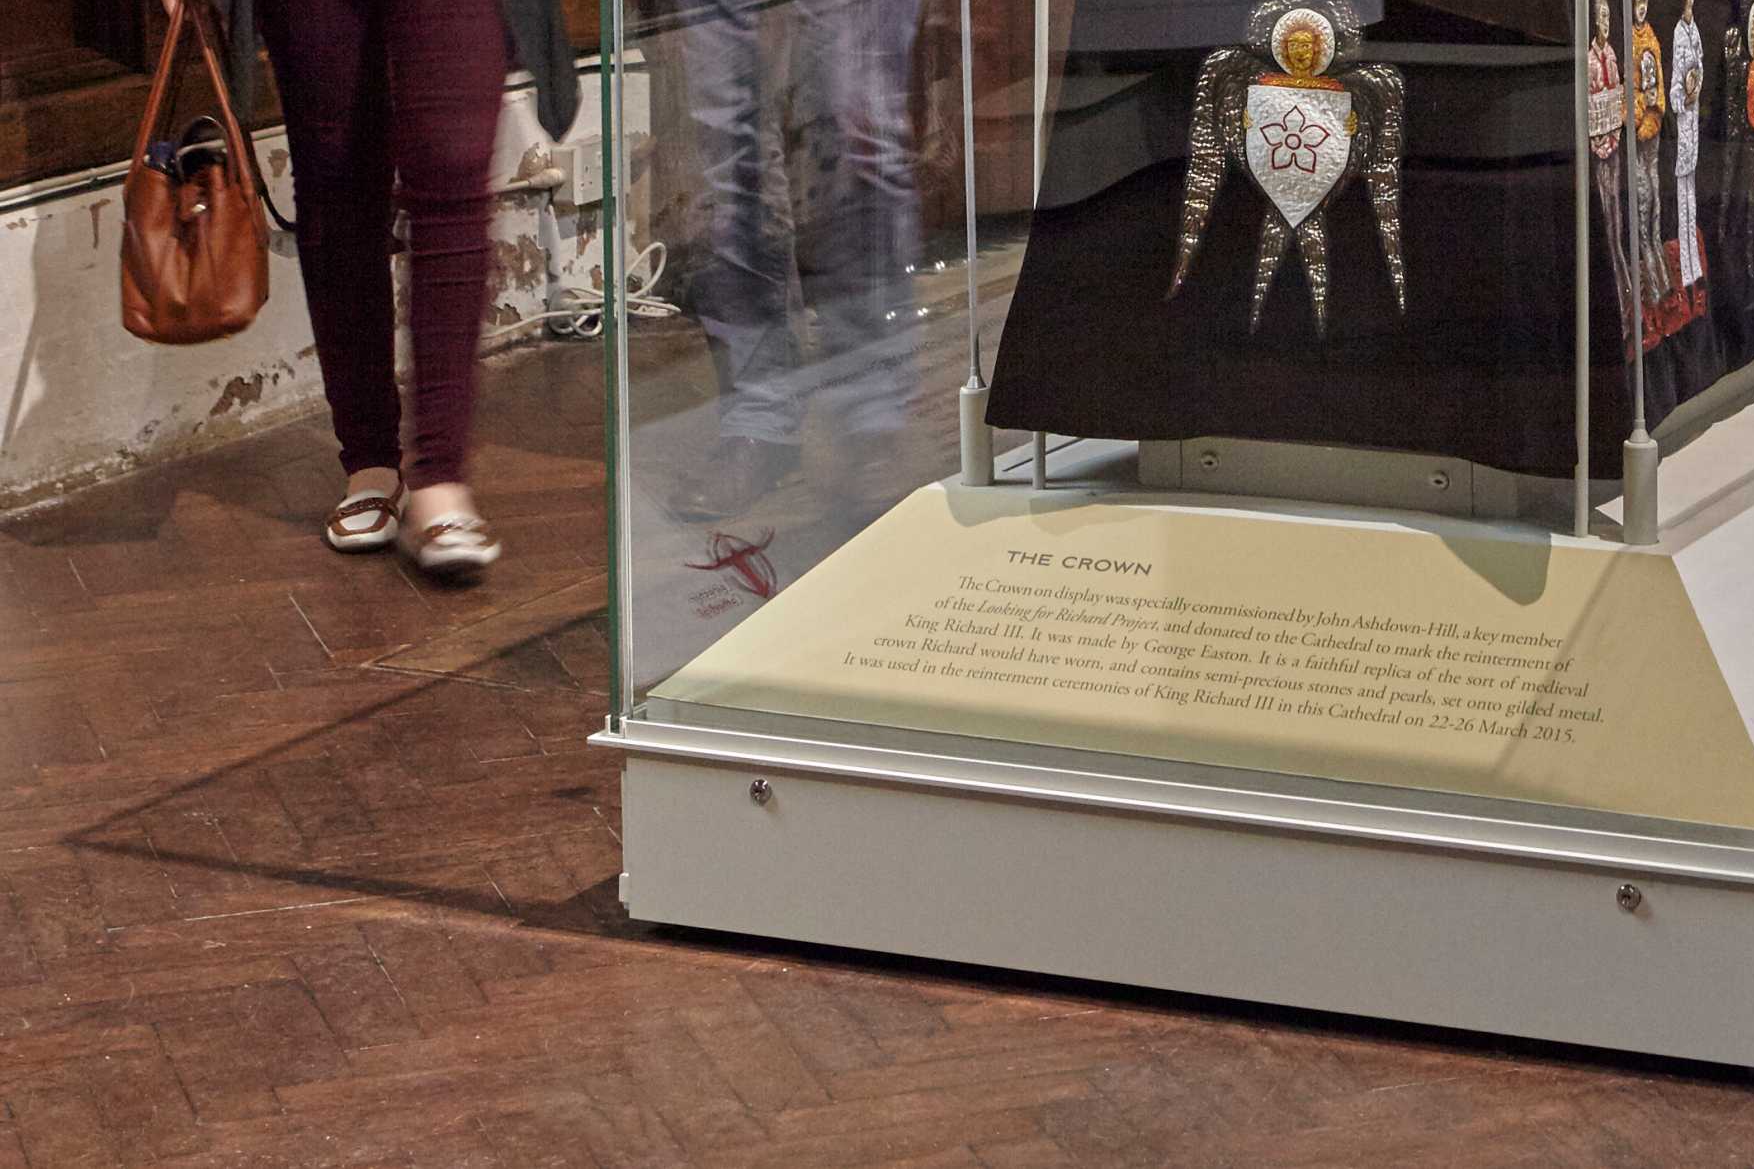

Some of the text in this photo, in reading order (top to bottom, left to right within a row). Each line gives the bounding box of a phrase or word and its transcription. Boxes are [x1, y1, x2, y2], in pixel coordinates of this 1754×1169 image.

[1007, 551, 1152, 577] THE CROWN
[934, 597, 952, 608] of
[953, 597, 975, 611] the
[976, 600, 1032, 622] Looking
[1028, 606, 1053, 622] for
[1055, 609, 1111, 625] Richard
[1163, 621, 1192, 634] and
[1194, 622, 1252, 640] donated
[1256, 632, 1270, 641] to
[1274, 630, 1297, 644] the
[1301, 633, 1374, 652] Cathedral
[1376, 644, 1390, 653] to
[1394, 644, 1431, 658] mark
[1436, 646, 1460, 660] the
[1463, 651, 1550, 669] reinterment
[1554, 659, 1575, 671] of
[959, 576, 982, 590] The
[985, 580, 1030, 595] Crown
[1033, 589, 1054, 597] on
[1054, 587, 1105, 604] display
[1106, 596, 1130, 605] was
[1131, 597, 1190, 614] specially
[1192, 604, 1295, 621] commissioned
[1296, 609, 1313, 627] by
[1313, 612, 1348, 627] John
[1350, 616, 1460, 639] Ashdown-Hill,
[1474, 627, 1499, 645] key
[1501, 633, 1563, 647] member
[874, 638, 915, 649] crown
[921, 638, 976, 655] Richard
[980, 647, 1024, 660] would
[1027, 649, 1060, 664] have
[1109, 660, 1137, 672] and
[1140, 666, 1200, 679] contains
[1204, 671, 1302, 690] semi-precious
[1306, 683, 1352, 695] stones
[1357, 686, 1386, 699] and
[1441, 697, 1462, 707] set
[1466, 700, 1501, 710] onto
[1505, 701, 1553, 717] gilded
[1557, 708, 1604, 722] metal.
[905, 615, 939, 633] King
[944, 618, 999, 635] Richard
[1002, 625, 1023, 638] III.
[1030, 627, 1042, 641] It
[1047, 634, 1072, 643] was
[1078, 634, 1116, 648] made
[1120, 636, 1138, 654] by
[1143, 640, 1195, 659] George
[1200, 645, 1252, 662] Easton.
[1259, 651, 1270, 664] It
[1275, 654, 1287, 665] is
[1302, 655, 1359, 673] faithful
[1363, 663, 1411, 680] replica
[1416, 668, 1434, 681] of
[1438, 670, 1461, 684] the
[1466, 677, 1494, 687] sort
[1499, 677, 1517, 689] of
[1521, 680, 1588, 697] medieval
[844, 652, 1575, 742] It was used in the reinterment ceremonies of King Richard III in this Cathedral on 22-26 March 2015.
